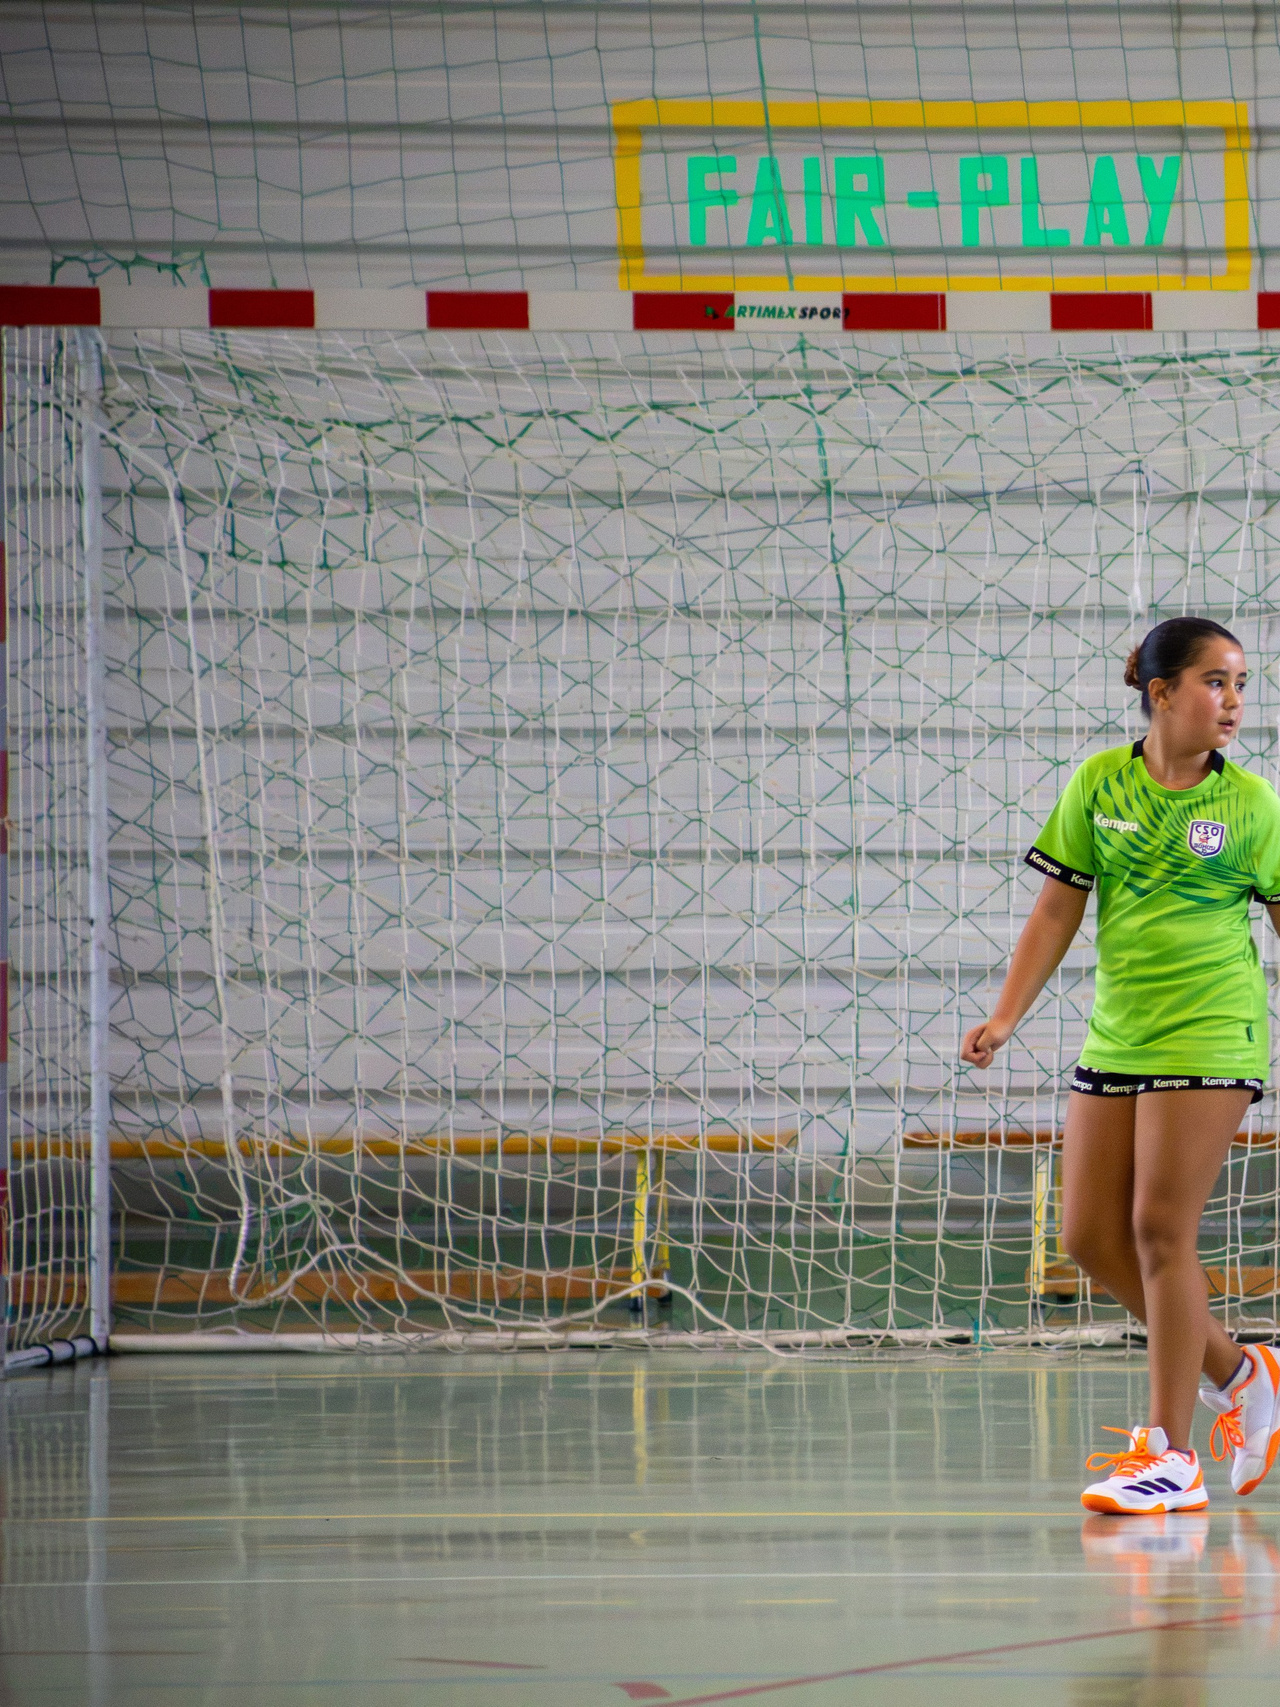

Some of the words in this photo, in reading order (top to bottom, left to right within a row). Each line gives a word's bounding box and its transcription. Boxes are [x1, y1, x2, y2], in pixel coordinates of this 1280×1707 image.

[1094, 813, 1139, 833] Kempa
[1195, 824, 1220, 837] CSO
[1029, 852, 1062, 876] Kempa
[1071, 873, 1094, 889] Kemp
[1153, 1079, 1190, 1089] Kempa
[1201, 1077, 1237, 1088] Kempa
